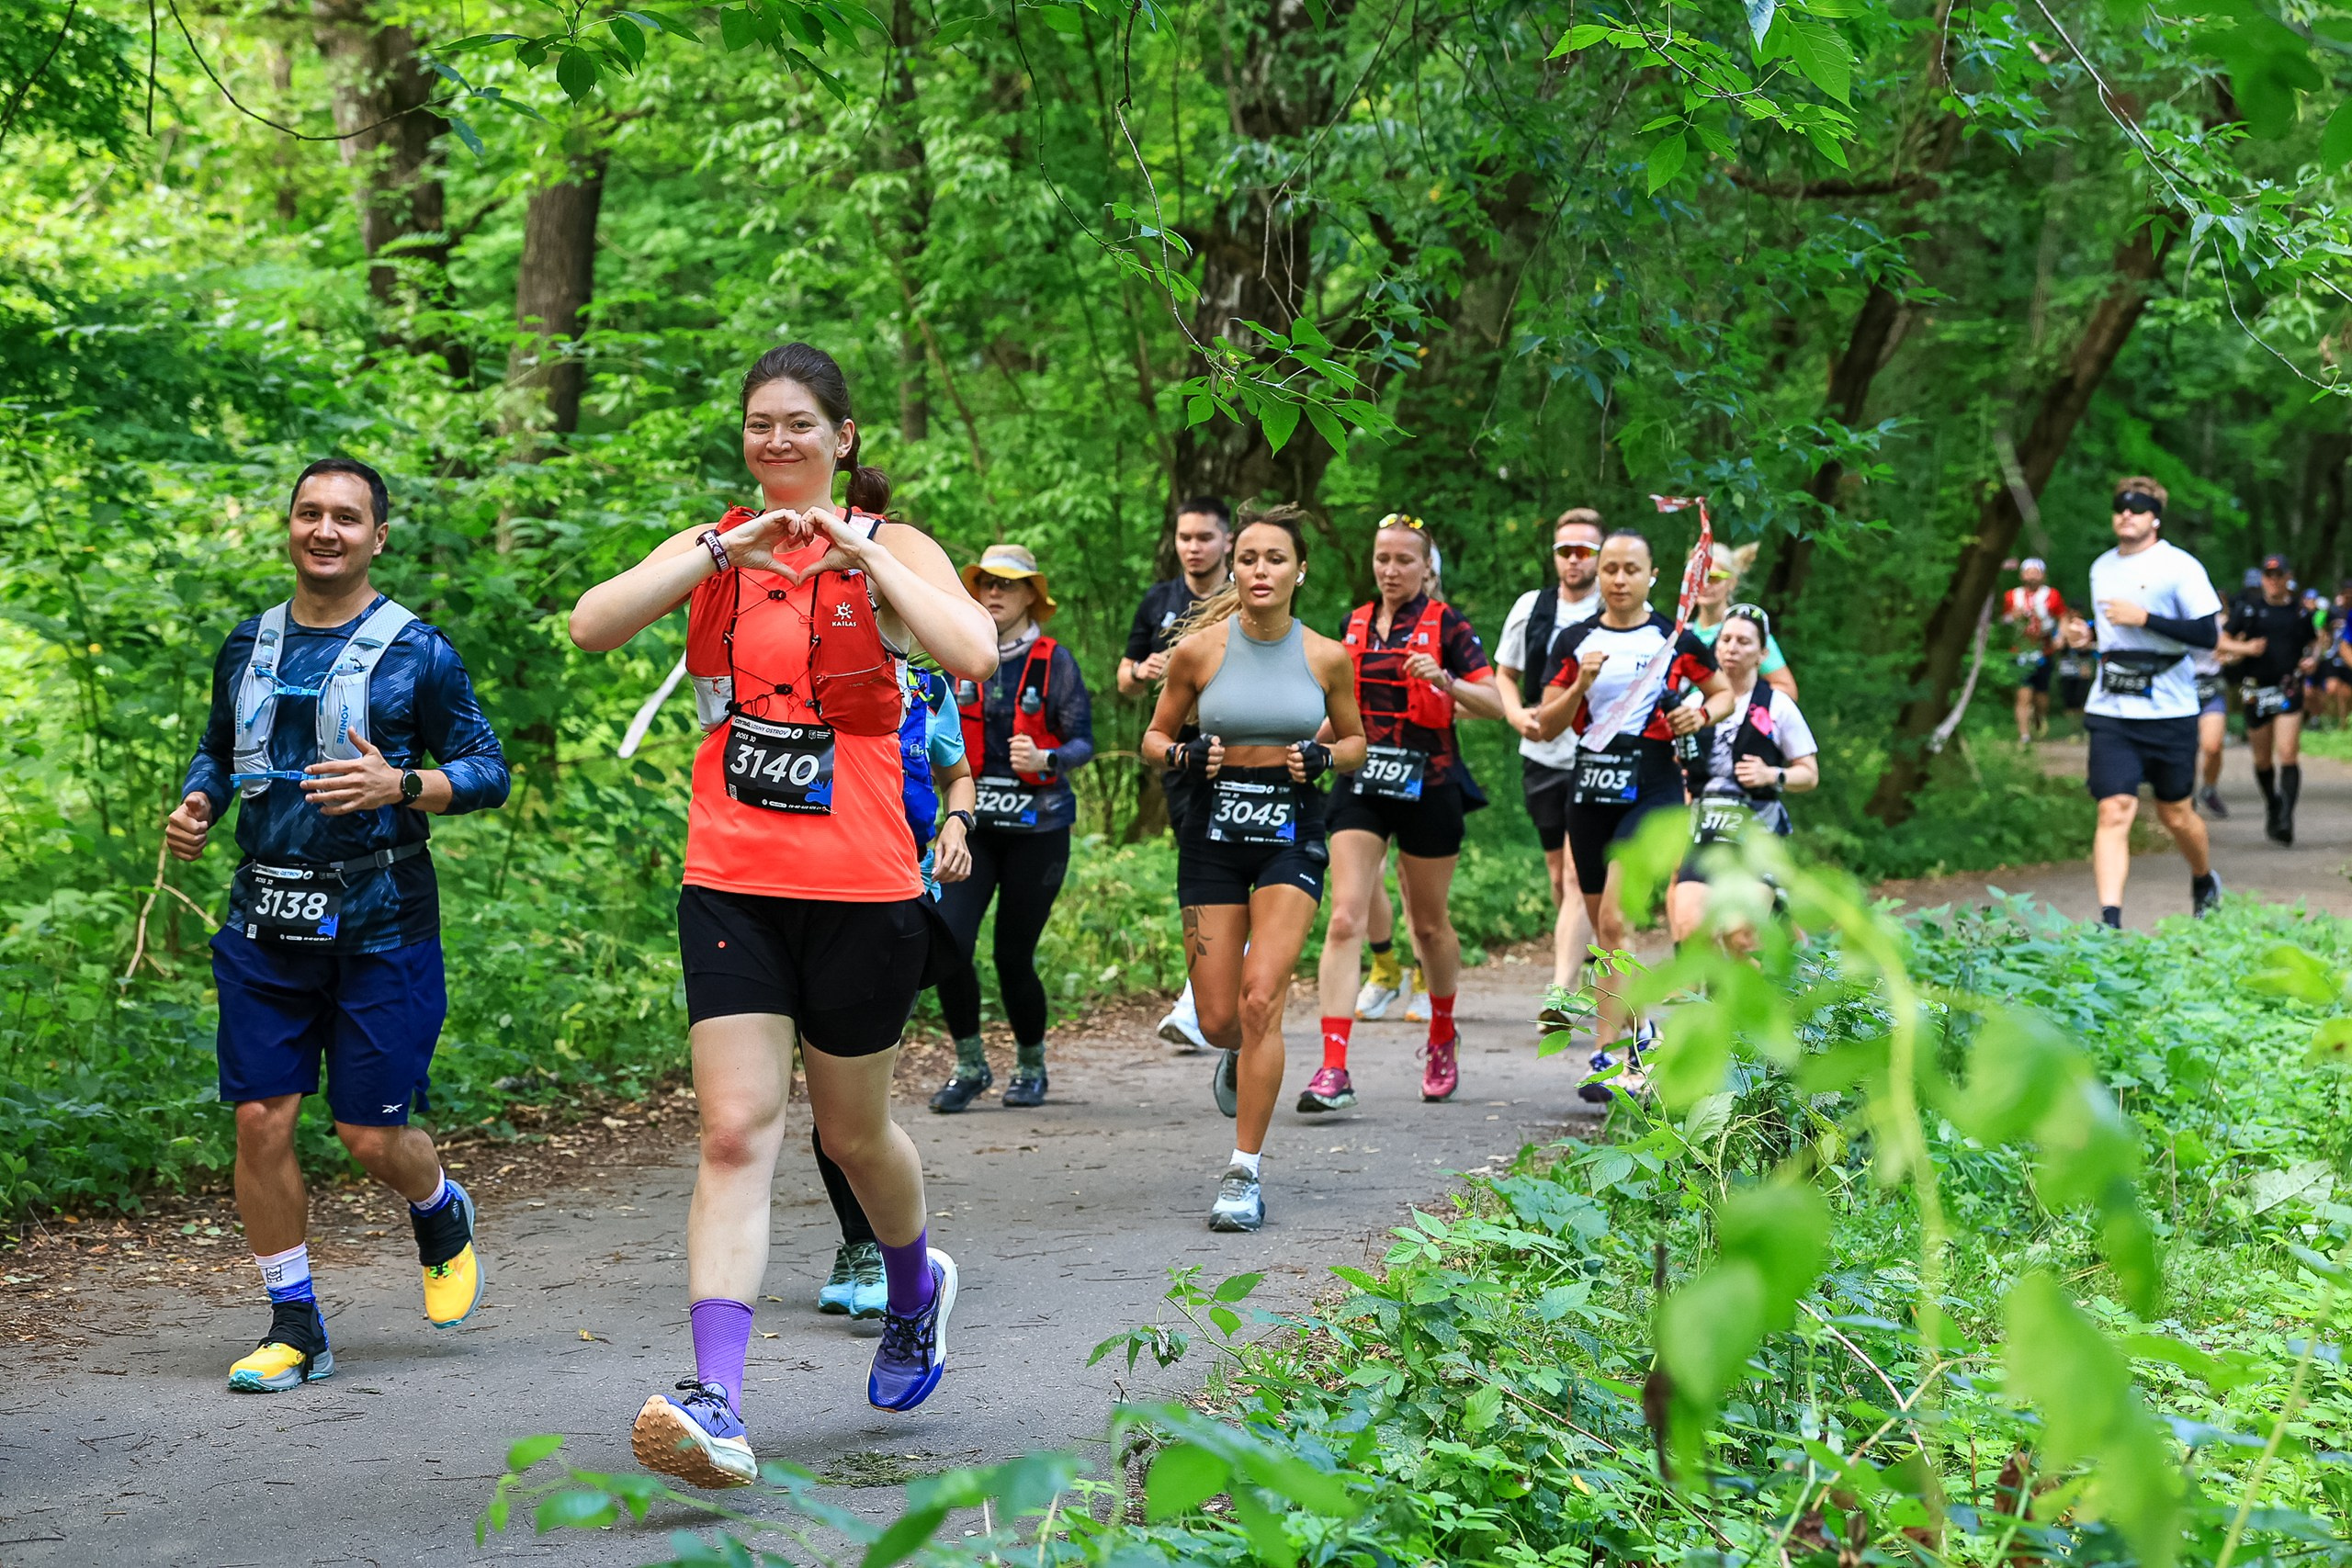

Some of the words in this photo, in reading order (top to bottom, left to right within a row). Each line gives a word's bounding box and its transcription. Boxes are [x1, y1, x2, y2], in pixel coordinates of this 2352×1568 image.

[735, 731, 749, 740] BOSS
[749, 735, 757, 743] 30
[765, 728, 788, 736] OSTROV
[729, 744, 820, 786] 3140
[1362, 759, 1414, 783] 3191
[1579, 768, 1632, 790] 3103
[975, 791, 1034, 813] 3207
[1215, 799, 1291, 827] 3045
[1702, 810, 1744, 831] 3112
[254, 887, 328, 920] 3138
